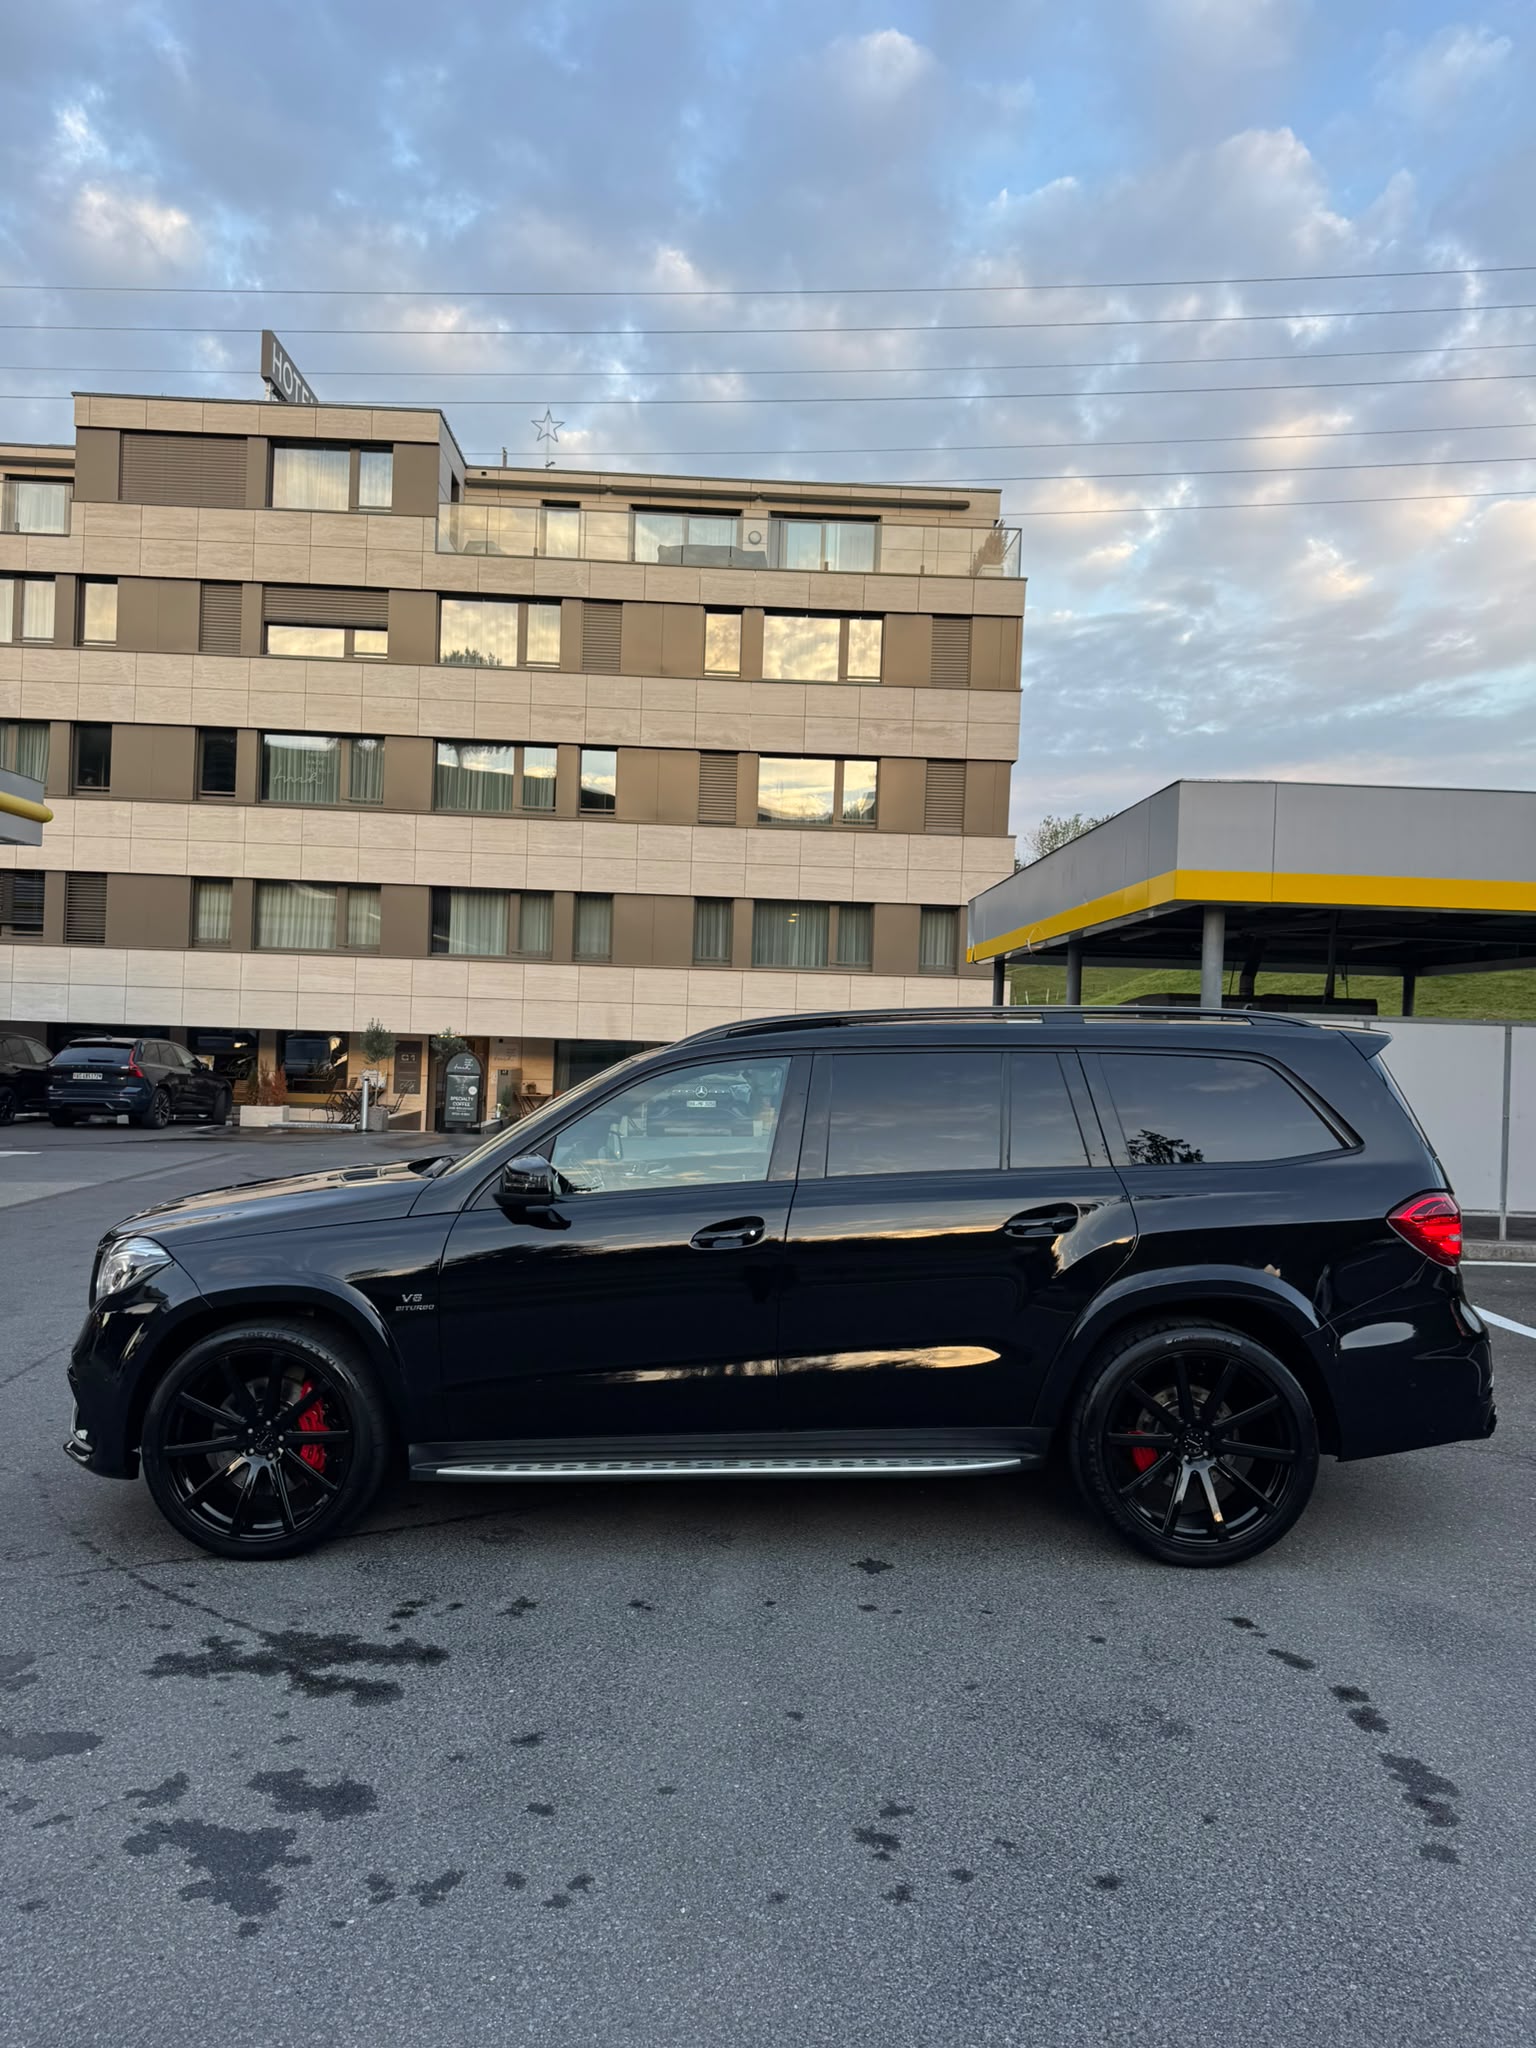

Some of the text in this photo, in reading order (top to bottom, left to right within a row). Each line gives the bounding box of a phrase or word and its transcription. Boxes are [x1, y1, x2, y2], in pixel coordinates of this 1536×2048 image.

[272, 342, 313, 404] HOTE
[401, 1293, 423, 1303] V8
[395, 1304, 435, 1312] BITURBO
